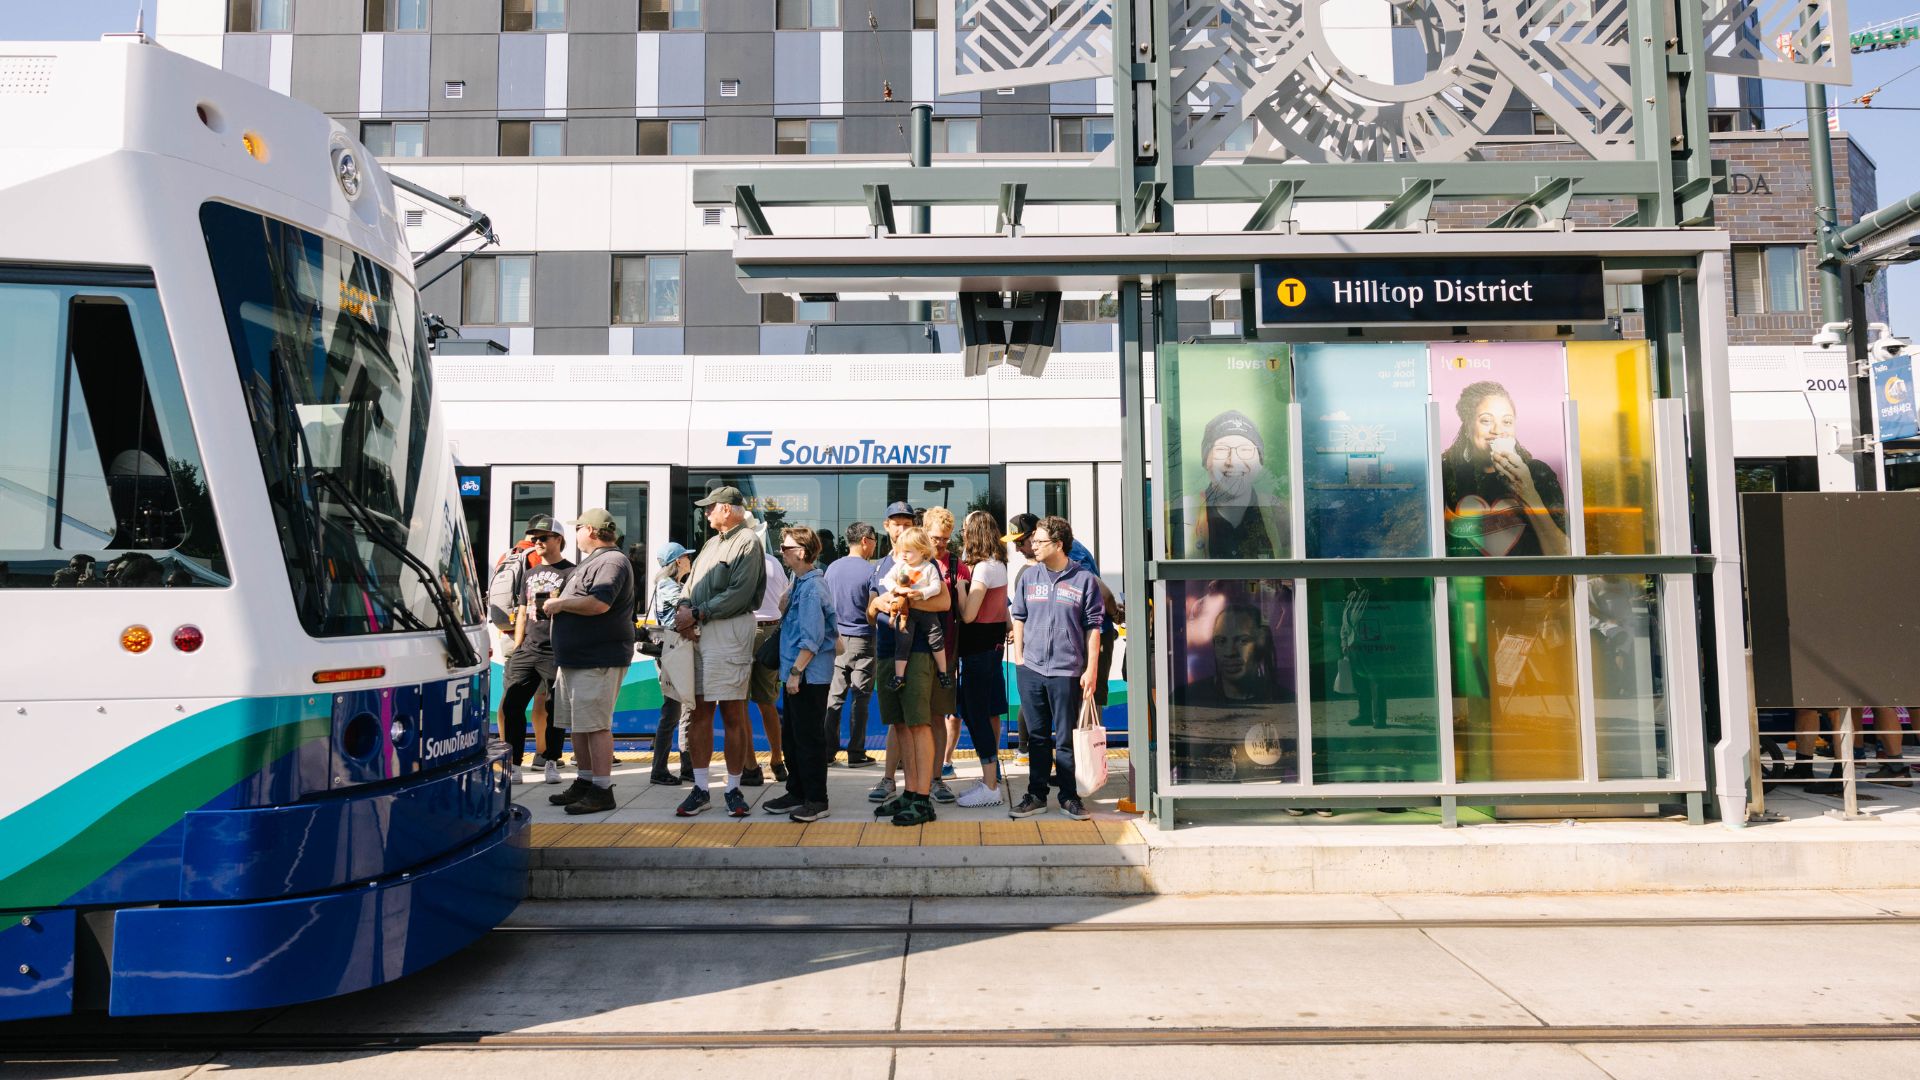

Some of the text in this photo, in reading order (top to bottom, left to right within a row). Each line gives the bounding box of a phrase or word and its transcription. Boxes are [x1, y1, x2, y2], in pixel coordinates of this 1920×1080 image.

[1849, 25, 1919, 47] WALSH
[1333, 280, 1424, 308] Hilltop
[1433, 279, 1533, 302] District
[1806, 379, 1847, 391] 2004
